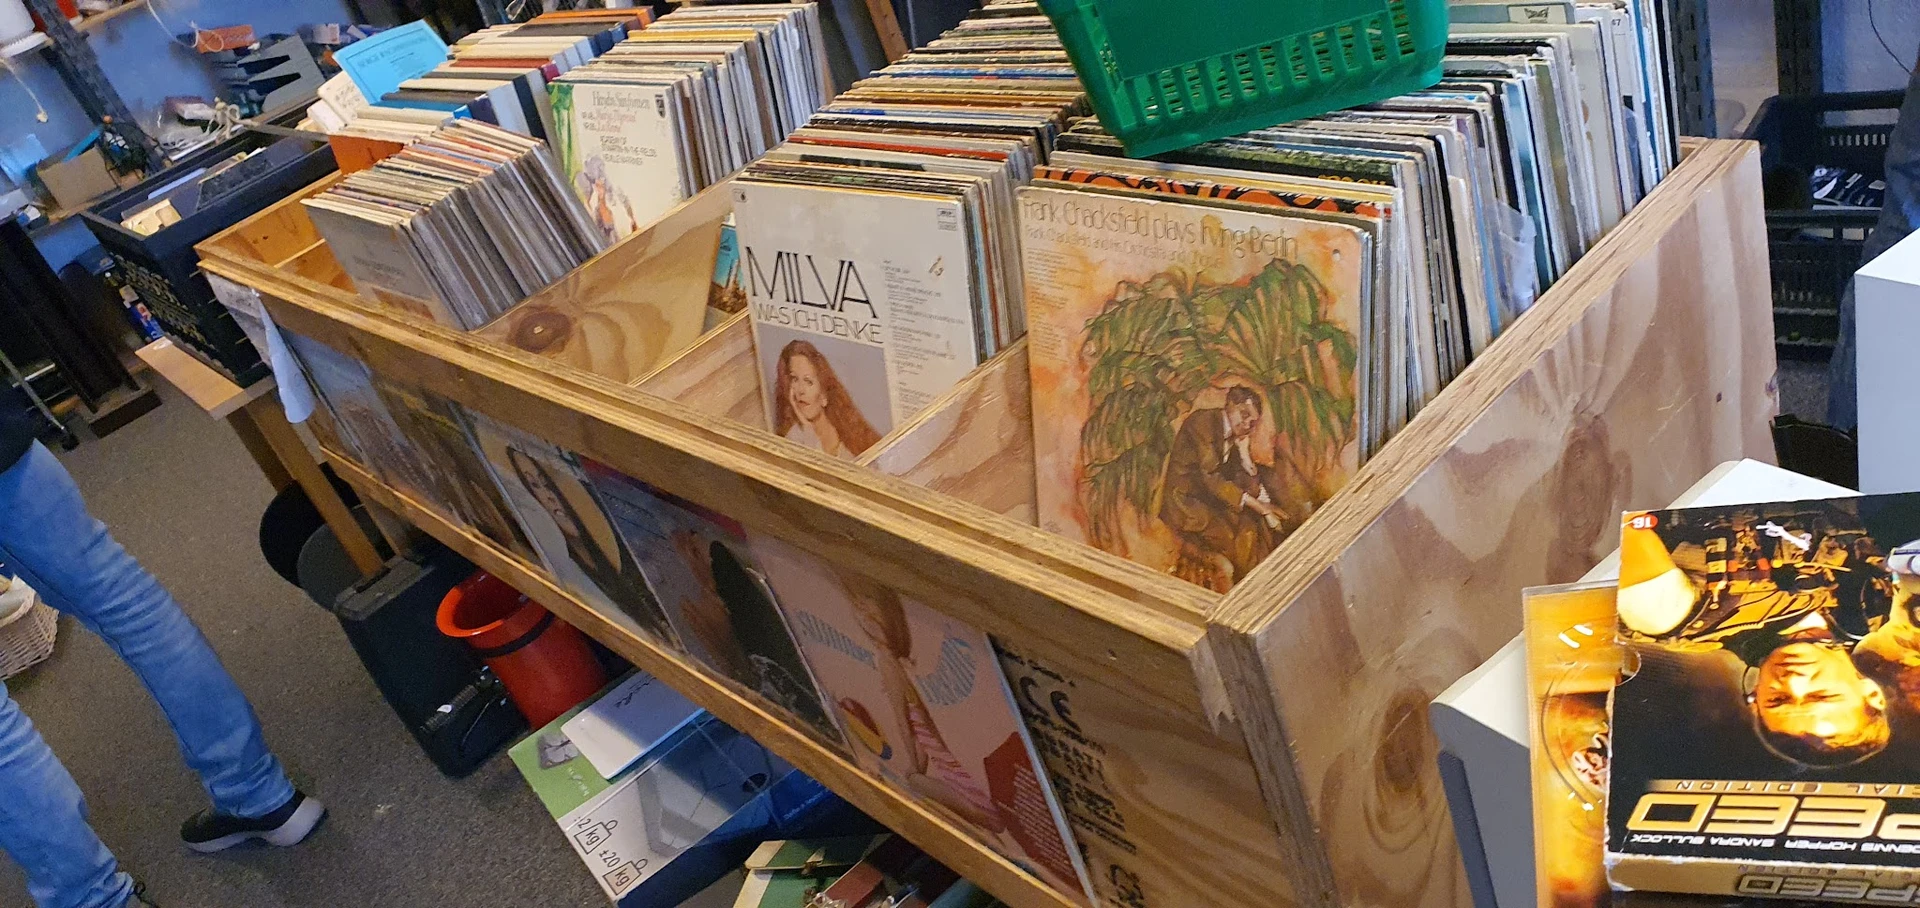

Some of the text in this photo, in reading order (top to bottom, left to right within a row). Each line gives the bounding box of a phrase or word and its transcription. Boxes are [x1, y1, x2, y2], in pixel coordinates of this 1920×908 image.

[1022, 195, 1060, 223] Frank
[1152, 211, 1197, 247] plays
[745, 246, 879, 319] MILVA
[753, 301, 884, 344] WAS ICH DENKE
[1633, 516, 1654, 529] 16
[1675, 780, 1821, 794] EDITION
[586, 828, 601, 846] kg
[1630, 833, 1706, 845] BULLOCK
[1710, 836, 1777, 848] SANDRA
[1784, 840, 1858, 851] HOPPER
[615, 868, 631, 887] kg
[1738, 875, 1920, 903] PEED
